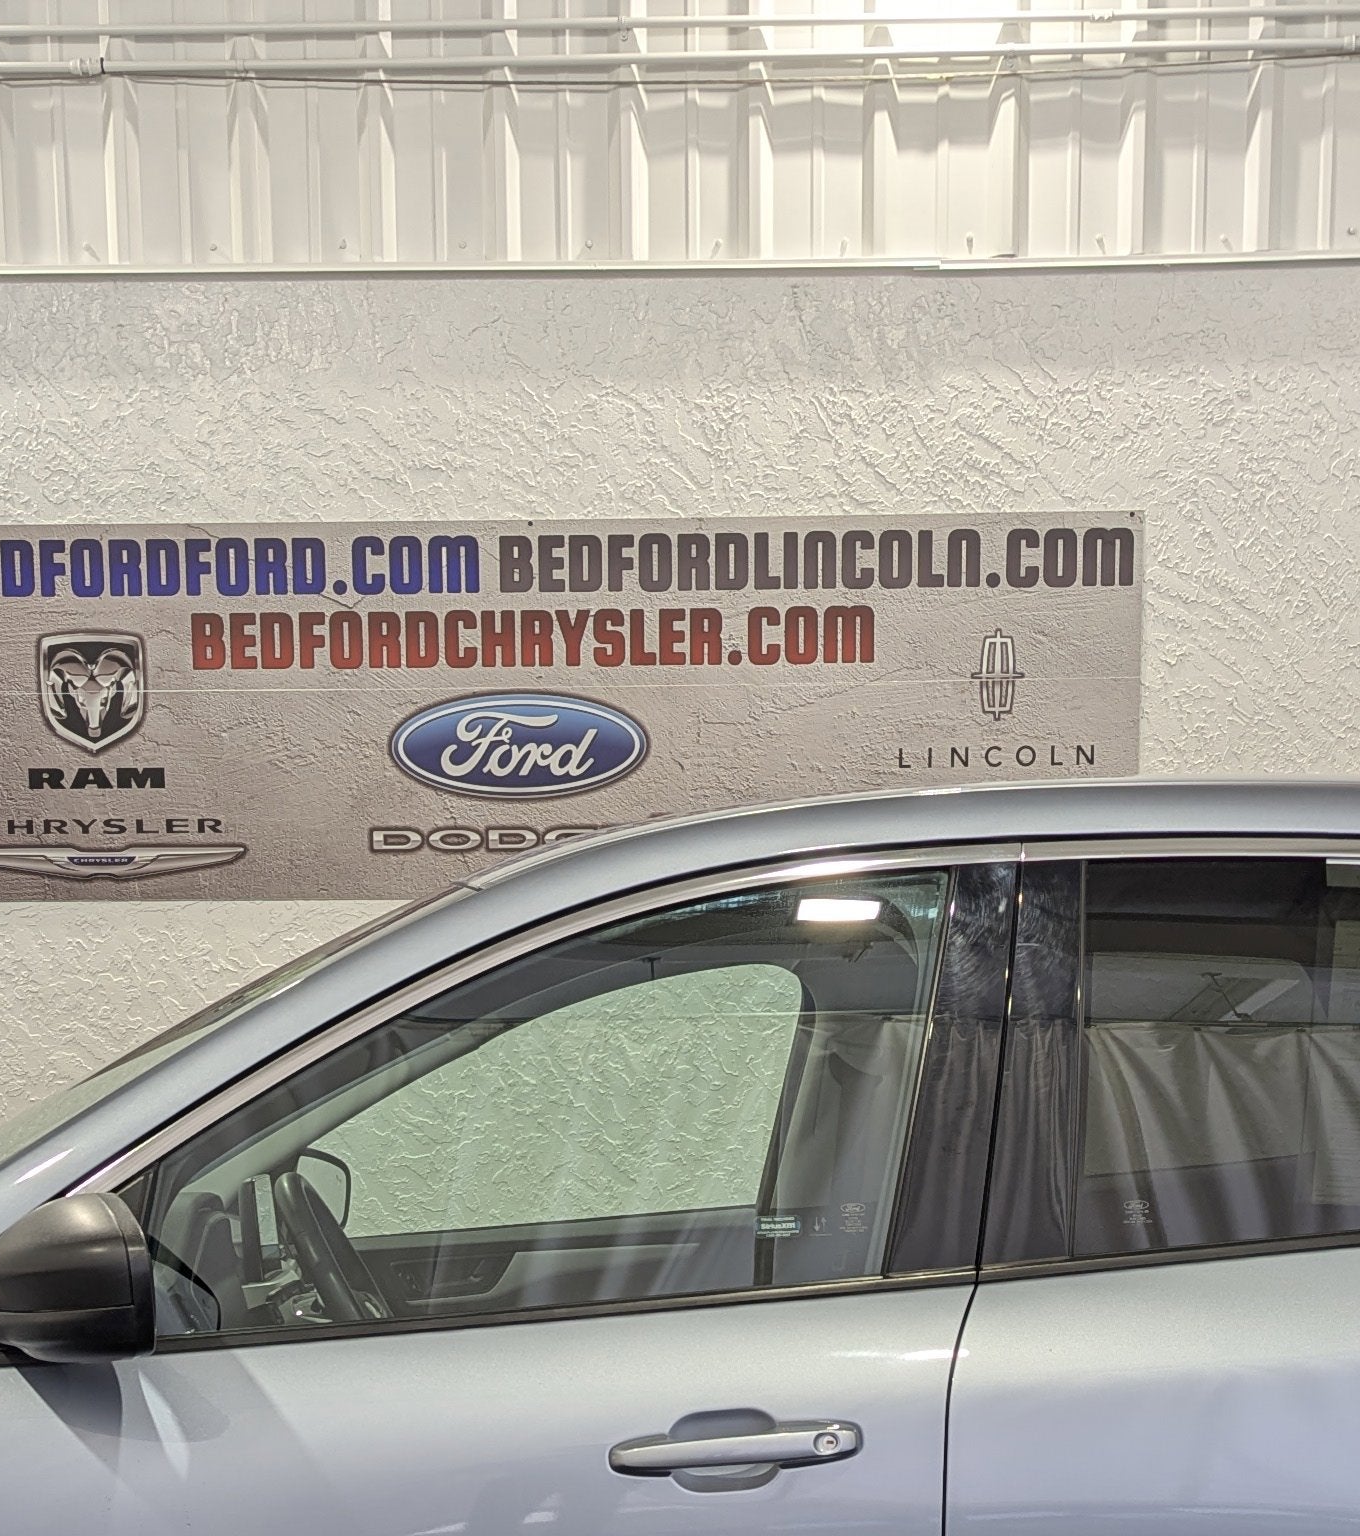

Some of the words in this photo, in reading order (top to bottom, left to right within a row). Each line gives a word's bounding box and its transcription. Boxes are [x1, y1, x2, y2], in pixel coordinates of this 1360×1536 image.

[499, 527, 1134, 594] BEDFORDLINCOLN.COM
[191, 605, 876, 670] BEDFORDCHRYSLER.COM
[440, 710, 596, 779] Ford
[898, 744, 1097, 769] LINCOLN
[28, 767, 166, 790] RAM
[372, 828, 597, 850] DOD
